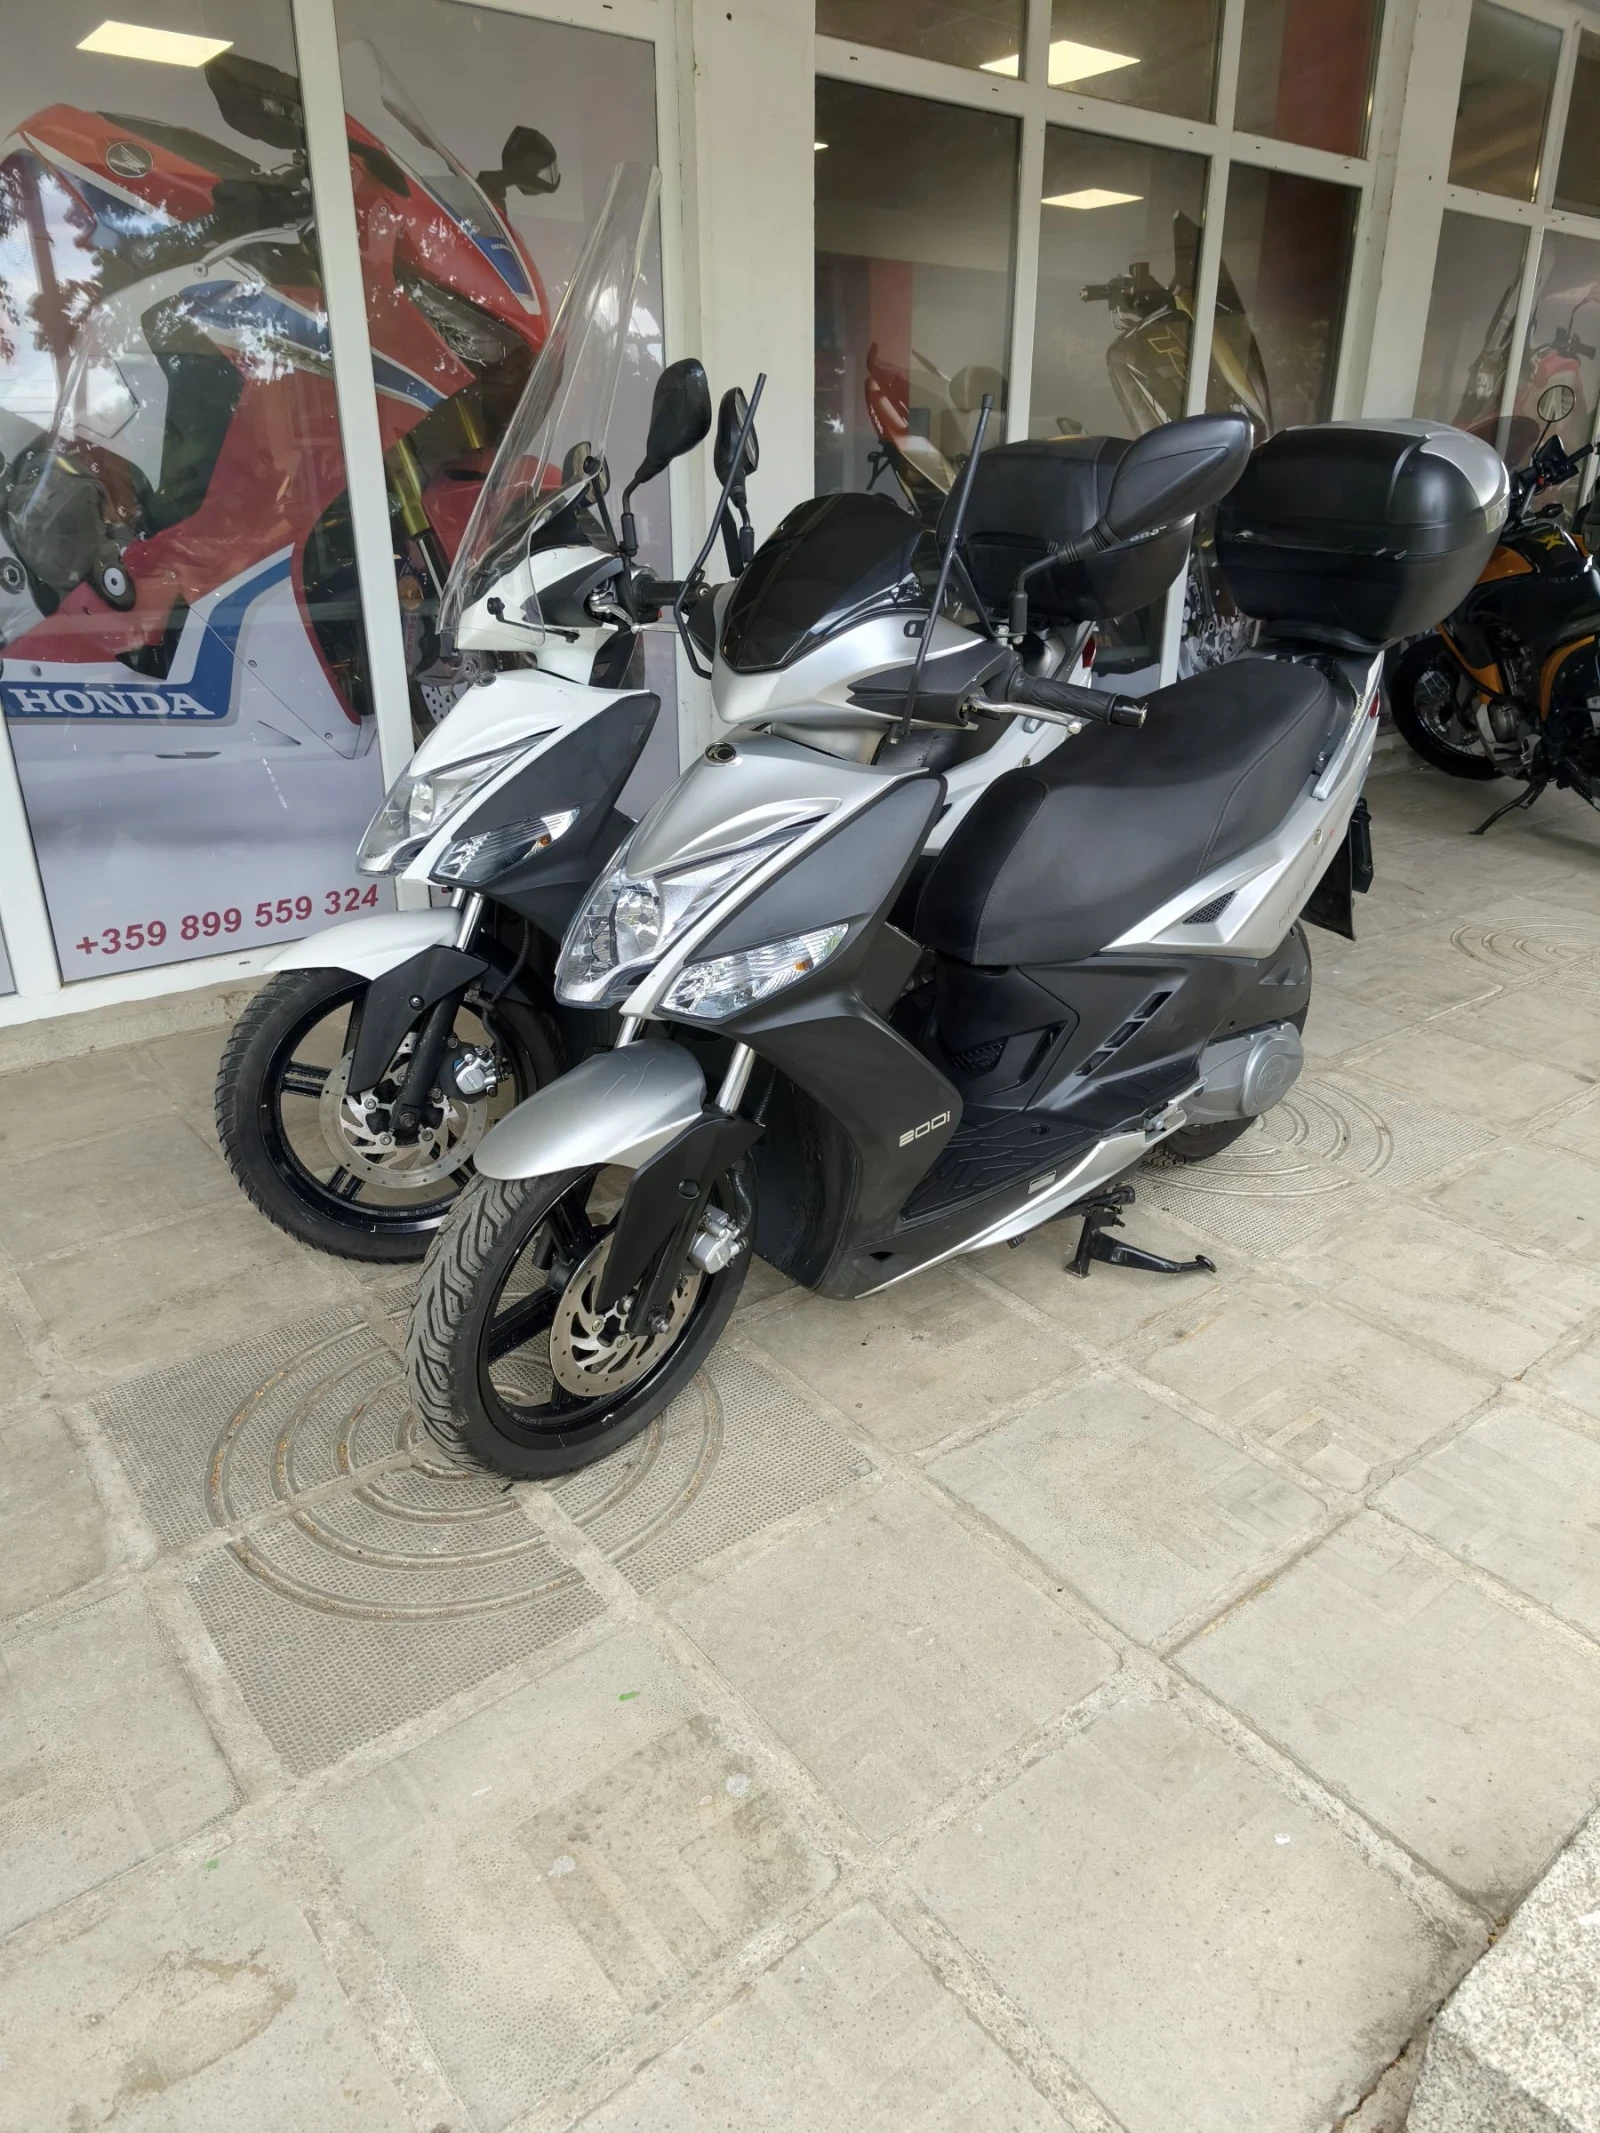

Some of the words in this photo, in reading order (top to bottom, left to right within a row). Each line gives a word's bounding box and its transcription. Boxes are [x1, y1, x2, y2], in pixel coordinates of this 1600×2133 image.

[7, 688, 216, 716] HONDA
[76, 920, 167, 956] +359
[180, 907, 242, 941] 899
[254, 895, 313, 928] 559
[323, 883, 380, 916] 324
[898, 1109, 951, 1148] 200i
